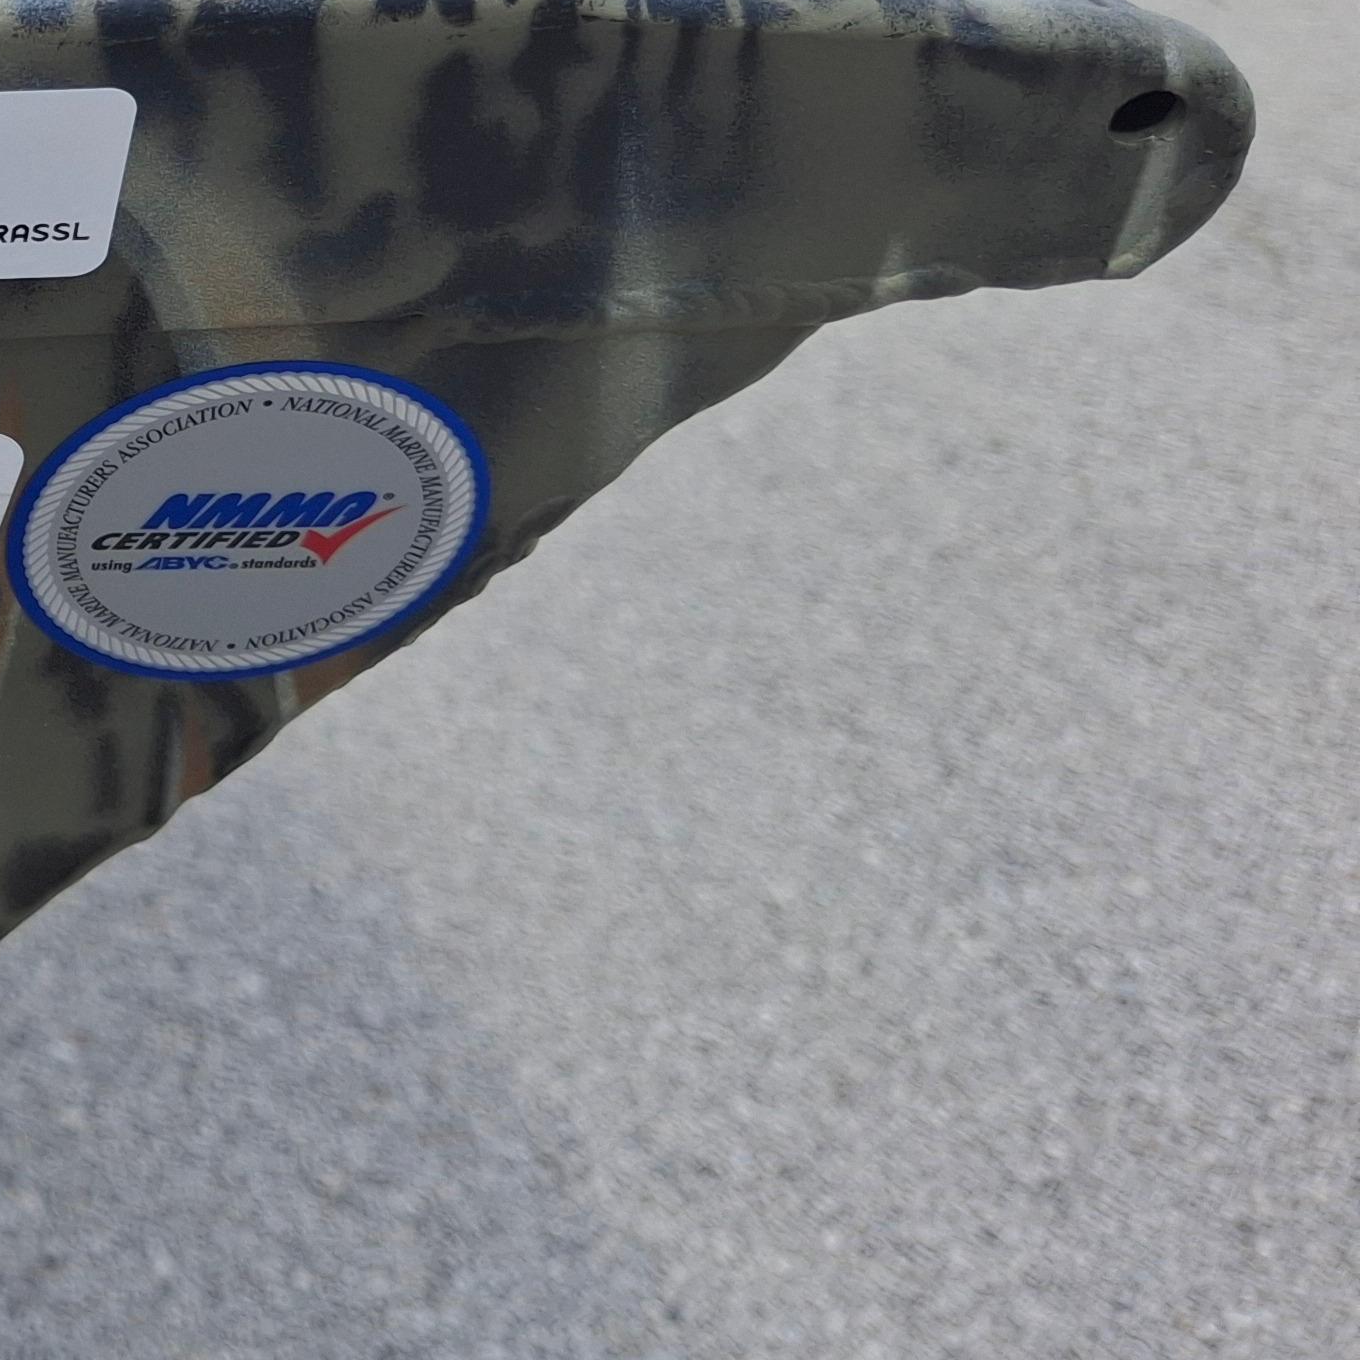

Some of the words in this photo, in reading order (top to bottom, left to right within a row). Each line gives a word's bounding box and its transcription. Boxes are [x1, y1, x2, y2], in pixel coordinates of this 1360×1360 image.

[116, 398, 254, 464] ASSOCIATION
[280, 396, 387, 431] NATIONAL
[379, 424, 437, 474] MARINE
[56, 459, 119, 582] MANUFACTURERS
[140, 490, 378, 530] NMMA
[90, 530, 301, 552] CERTIFIED
[374, 474, 444, 595] MANUFACTURERS
[91, 558, 133, 574] using
[241, 555, 317, 570] standards
[67, 582, 126, 629] MARINE
[244, 591, 375, 651] ASSOCIATION
[118, 622, 220, 653] NATIONAL
